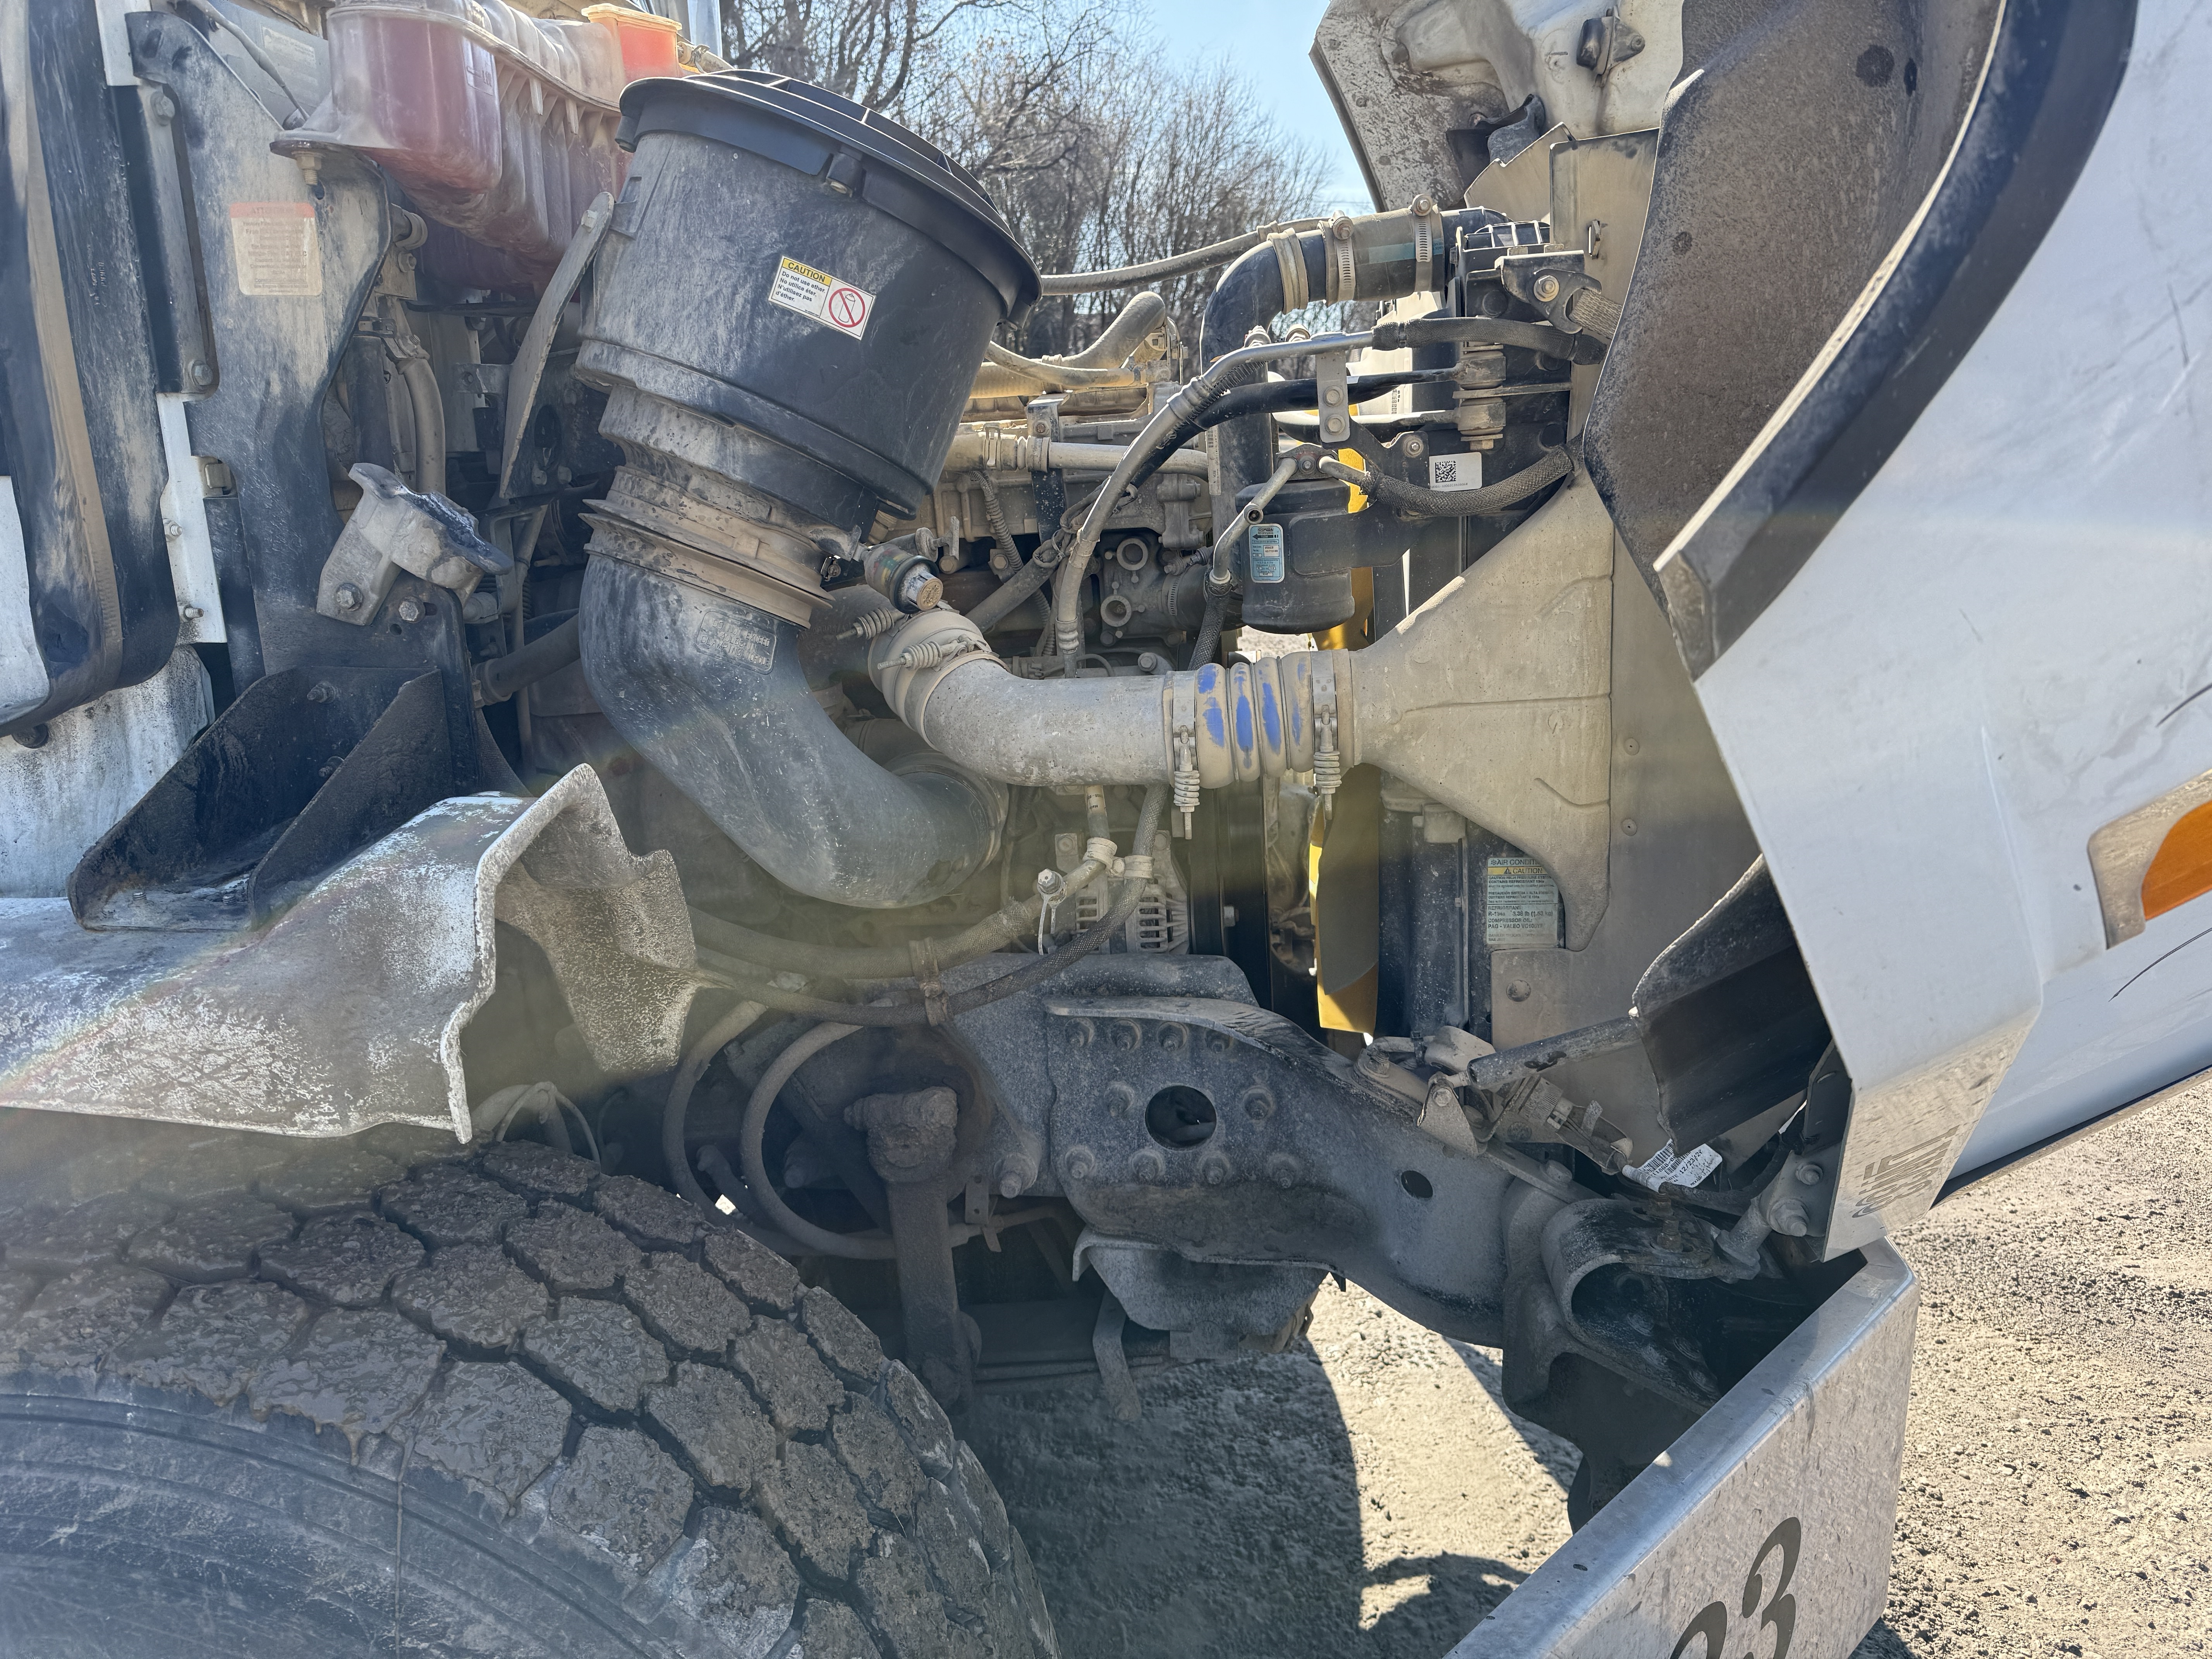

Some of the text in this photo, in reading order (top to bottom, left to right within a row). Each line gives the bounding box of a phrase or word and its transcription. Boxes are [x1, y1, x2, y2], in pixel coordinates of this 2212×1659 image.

[788, 262, 826, 283] CAUTION
[790, 274, 800, 282] not
[712, 619, 724, 629] DO
[746, 632, 771, 647] EXCEED
[700, 636, 770, 667] CLAMPING TORQUE
